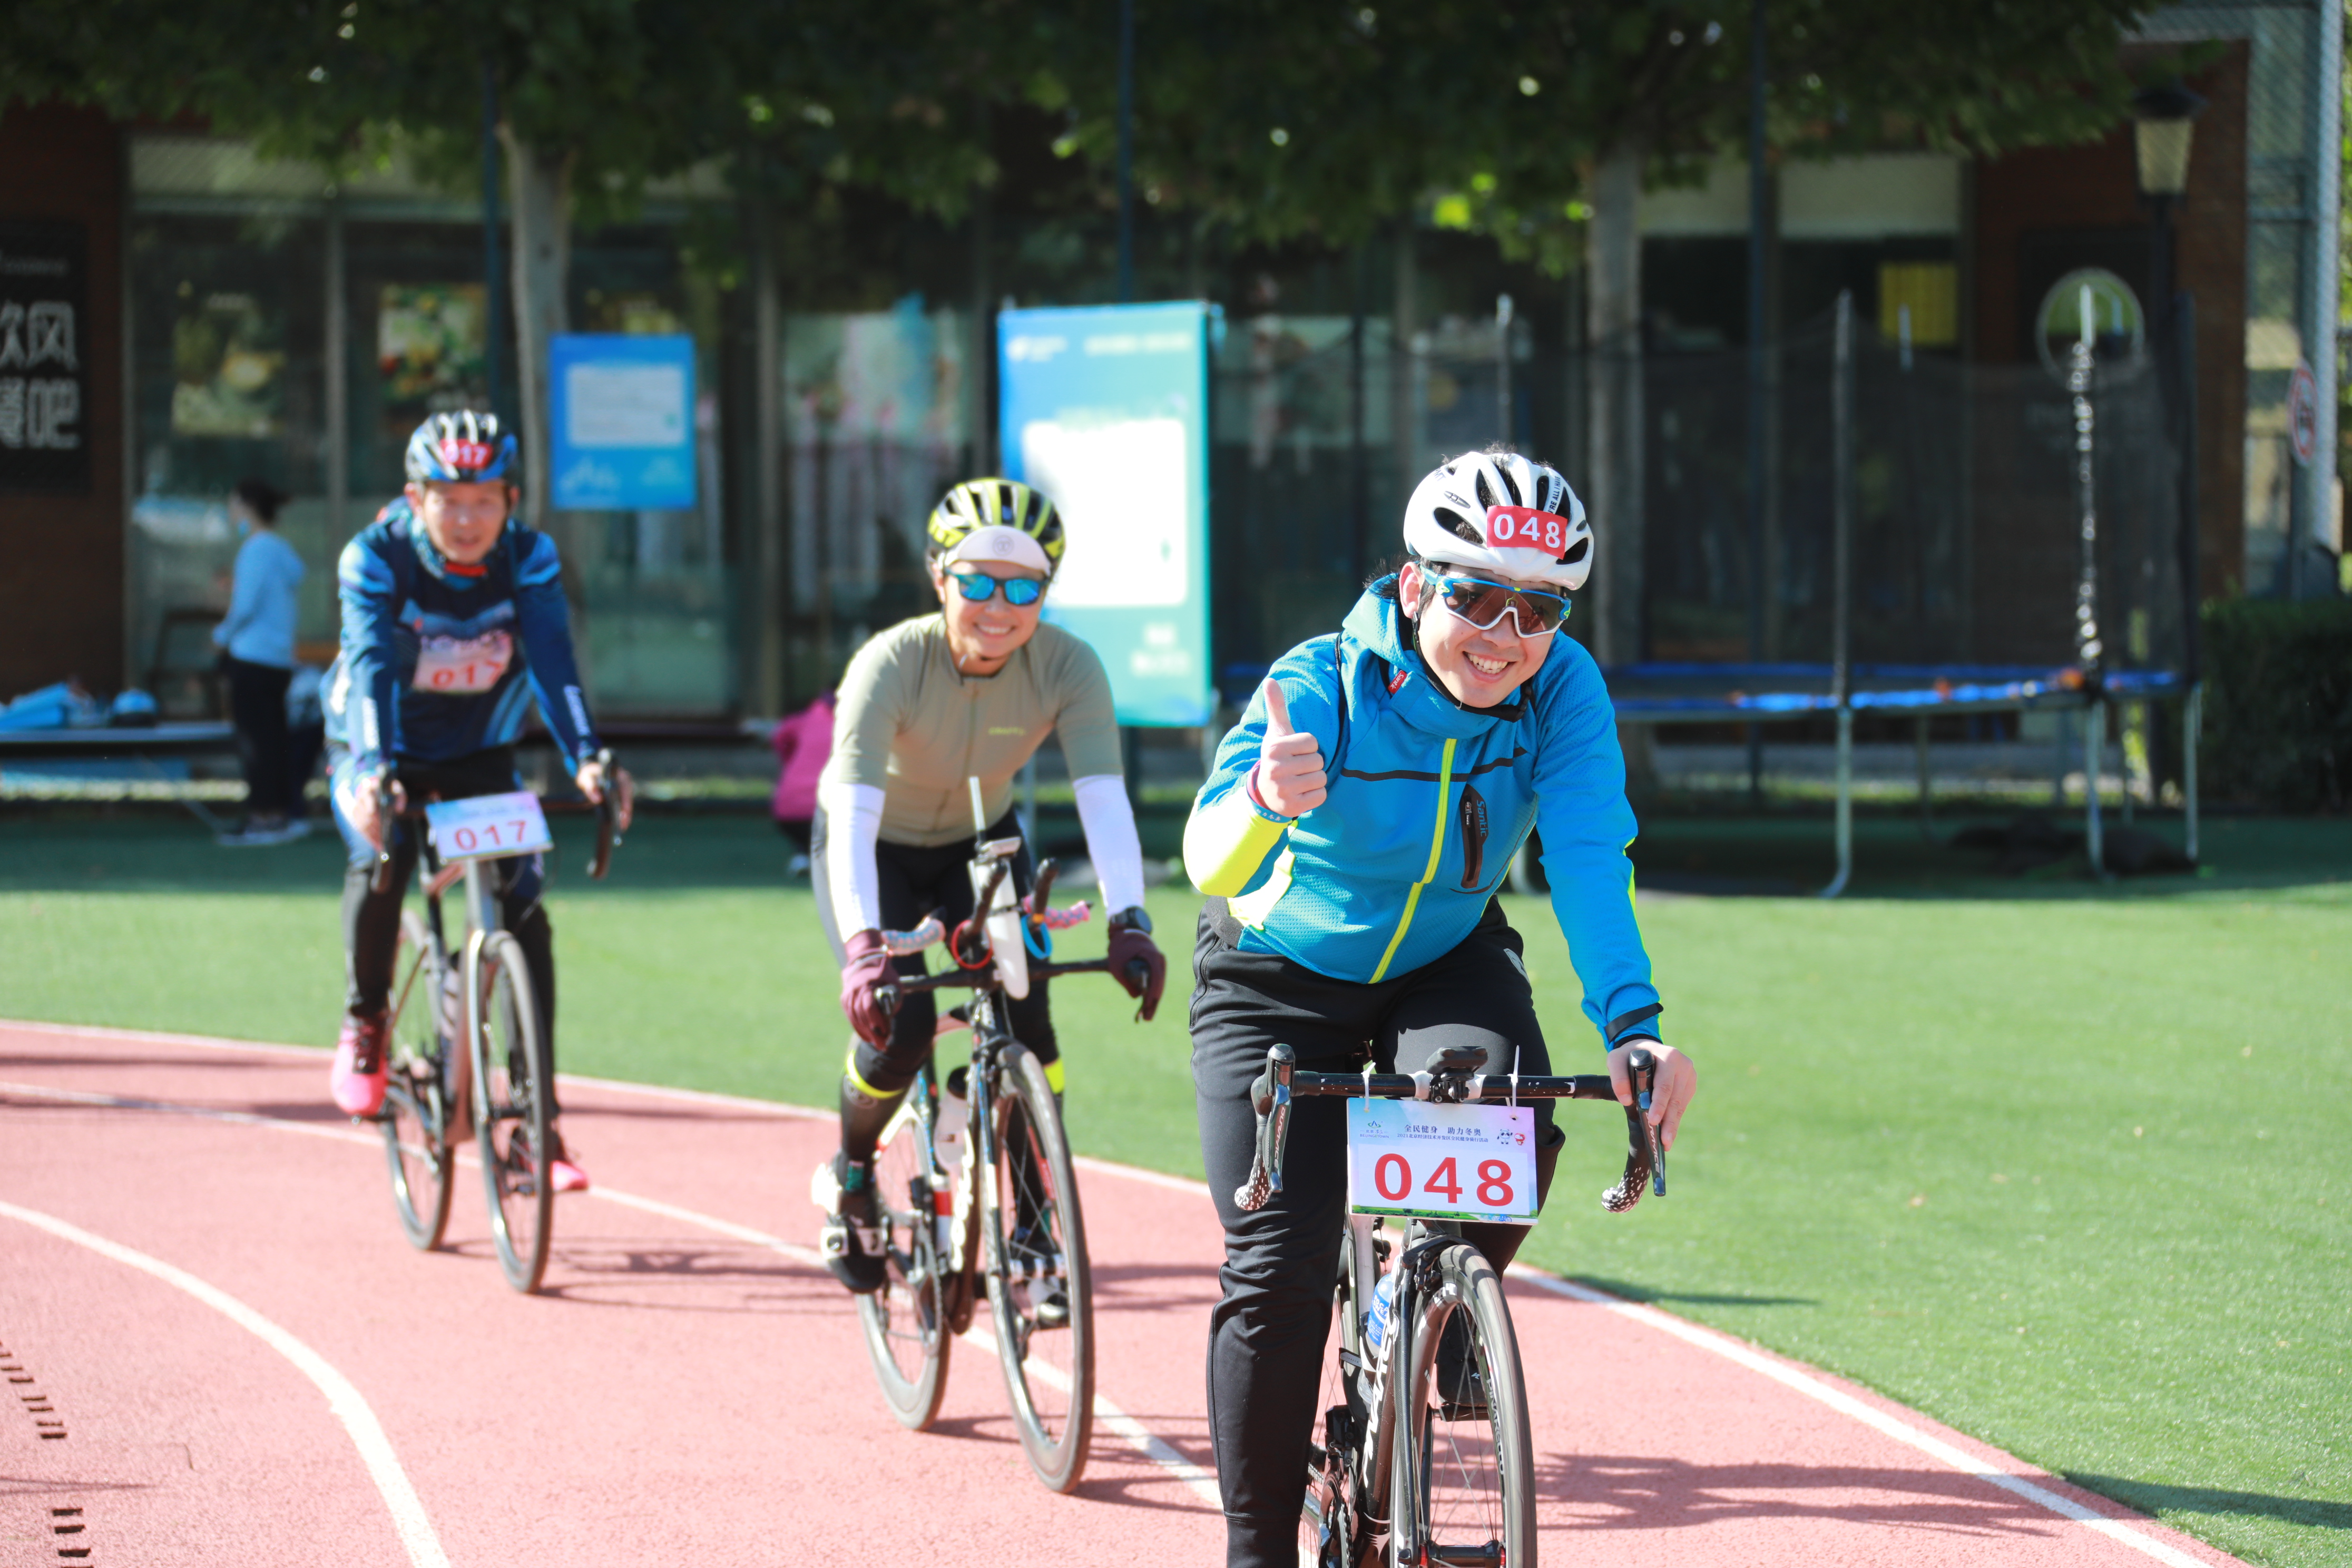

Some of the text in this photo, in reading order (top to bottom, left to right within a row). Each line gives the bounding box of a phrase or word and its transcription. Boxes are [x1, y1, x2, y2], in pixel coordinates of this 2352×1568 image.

[445, 444, 487, 464] 017
[1494, 514, 1561, 548] 048
[432, 659, 502, 688] 017
[1389, 672, 1404, 690] Santic
[1477, 799, 1488, 837] Santic
[454, 820, 526, 851] 017
[1274, 1106, 1286, 1169] DURA-ACE
[1404, 1124, 1482, 1136] 全民健身 助力冬奥
[1374, 1153, 1514, 1207] 048
[1374, 1294, 1389, 1311] POCA
